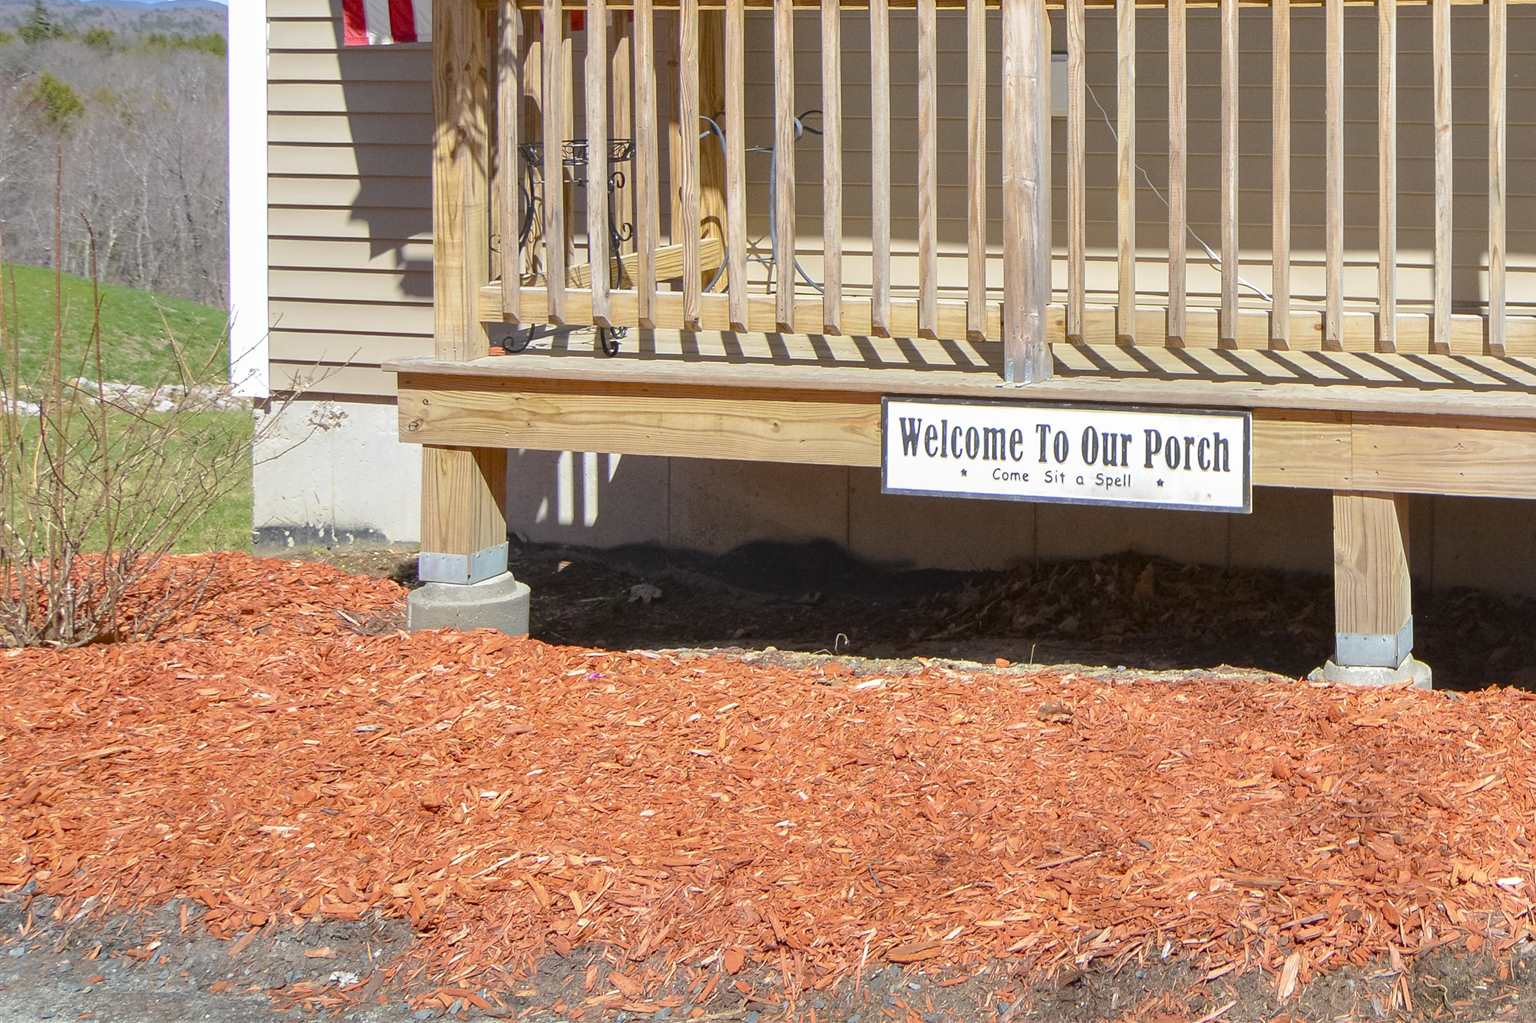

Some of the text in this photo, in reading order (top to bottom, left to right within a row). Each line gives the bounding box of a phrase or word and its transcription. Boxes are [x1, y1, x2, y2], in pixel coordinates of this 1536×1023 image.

[899, 416, 1231, 472] Welcome To Our Porch
[992, 467, 1132, 490] Come Sit a Spell
